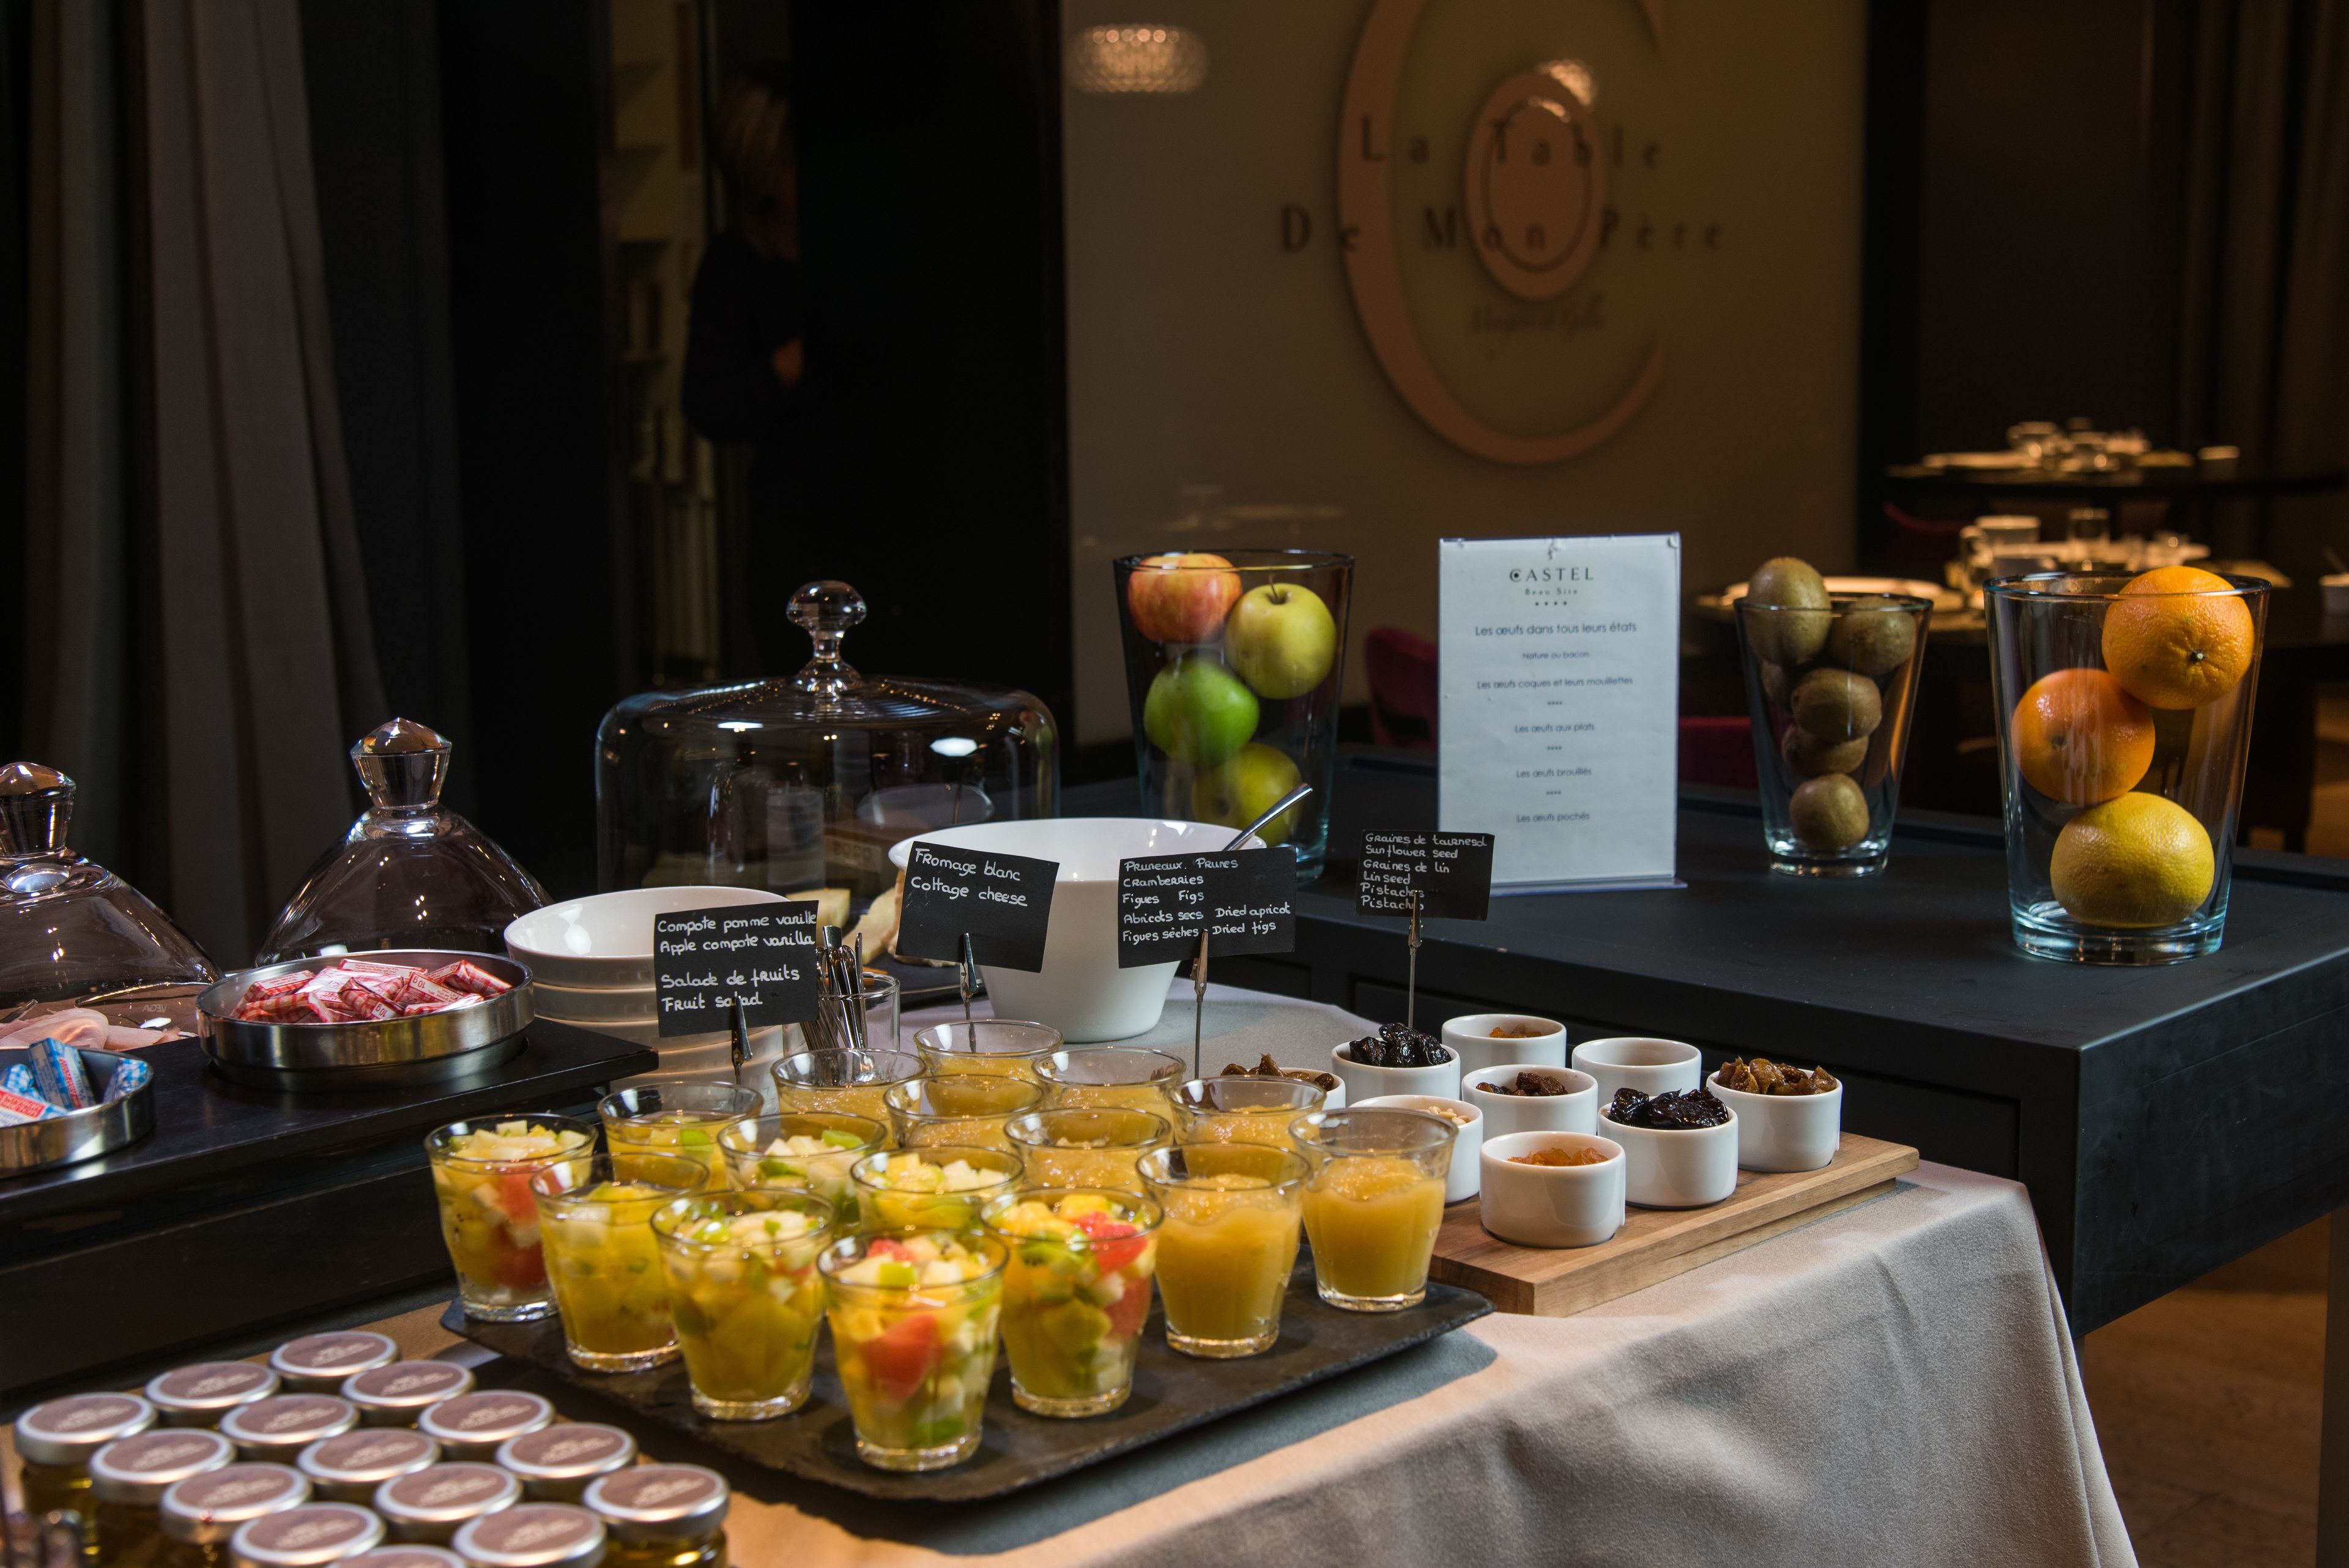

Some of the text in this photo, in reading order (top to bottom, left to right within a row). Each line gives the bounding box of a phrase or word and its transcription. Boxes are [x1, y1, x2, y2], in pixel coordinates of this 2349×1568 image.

[1360, 115, 1661, 170] La Table
[1280, 204, 1360, 252] De
[1422, 206, 1547, 251] Mon
[1509, 567, 1594, 582] CASTEL
[1525, 587, 1578, 596] Beau Site
[1475, 626, 1493, 636] Les
[1526, 623, 1553, 634] dans
[1556, 623, 1579, 634] tous
[1582, 622, 1606, 633] leurs
[1609, 622, 1637, 633] états
[1523, 652, 1549, 660] Nature
[1477, 680, 1491, 689] Les
[1518, 679, 1551, 689] coques
[1564, 678, 1584, 686] leurs
[1586, 677, 1633, 685] mouillettes
[1515, 725, 1529, 734] Les
[1573, 723, 1595, 733] plats
[1516, 770, 1531, 778] Les
[1557, 768, 1592, 777] brouillés
[1516, 814, 1531, 823] Les
[1557, 812, 1590, 823] pochés
[1365, 833, 1411, 844] Graines
[1413, 834, 1427, 845] de
[1433, 849, 1458, 858] seed
[915, 848, 1021, 881] Fromage blanc
[1195, 857, 1239, 869] Prunes
[1363, 859, 1450, 874] Graines de lin
[911, 876, 1028, 907] Cottage cheese
[1122, 890, 1204, 909] Figues Figs
[1123, 901, 1291, 924] Abricots secs Dried apricot
[657, 915, 716, 936] Compote
[775, 910, 817, 926] vanille
[1123, 930, 1159, 945] Figues
[1212, 922, 1245, 935] Dried
[660, 930, 815, 956] Apple compote vanilla
[660, 964, 800, 989] Salade de fruits
[661, 992, 706, 1013] Fruit
